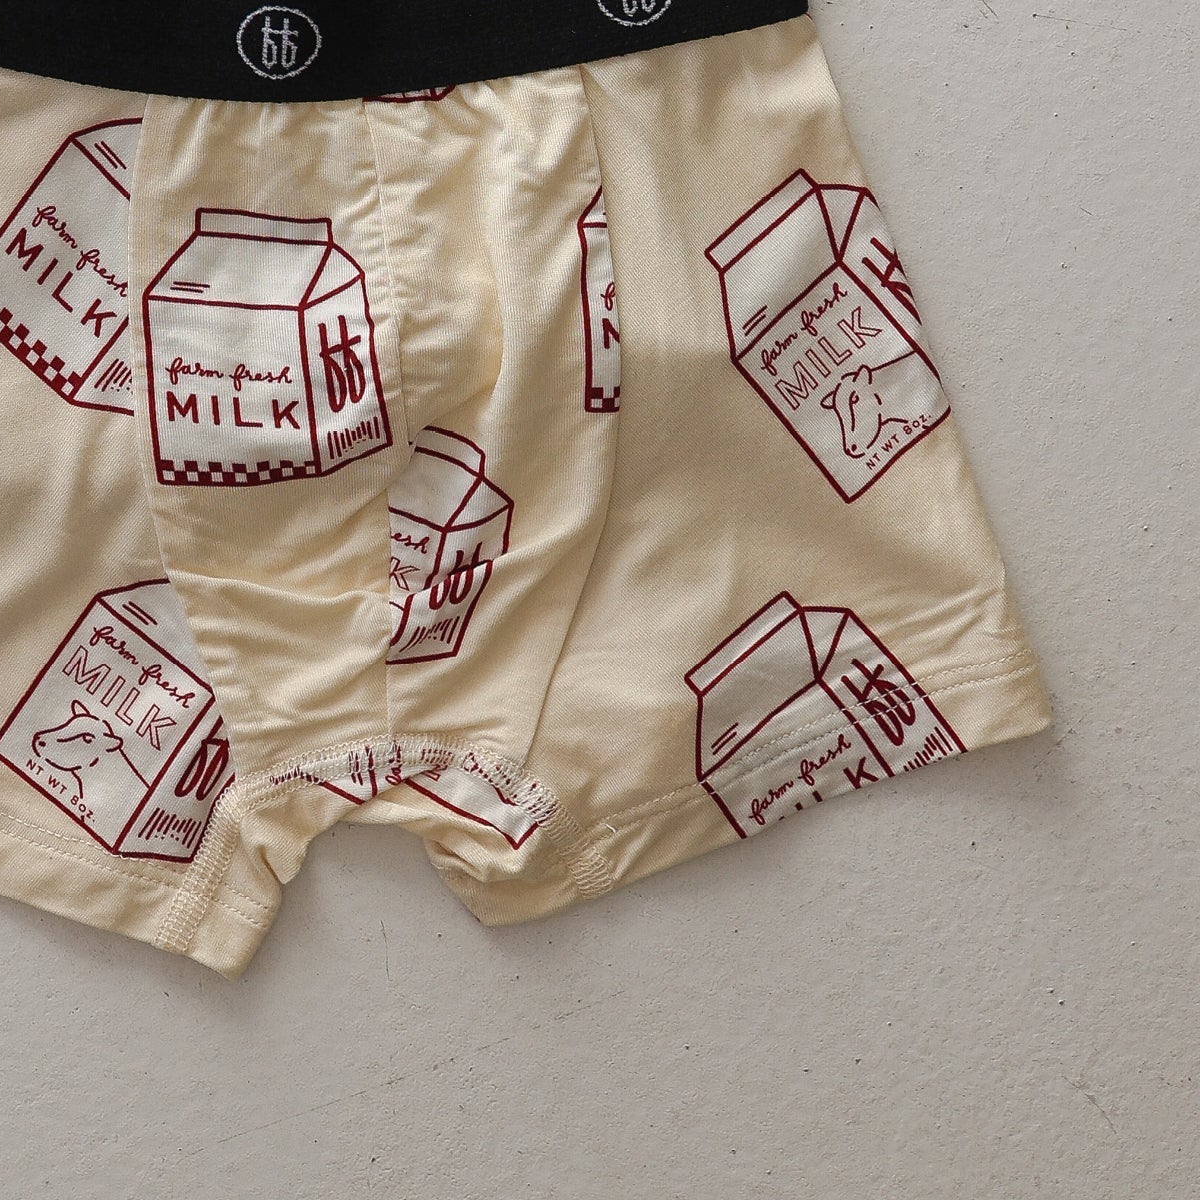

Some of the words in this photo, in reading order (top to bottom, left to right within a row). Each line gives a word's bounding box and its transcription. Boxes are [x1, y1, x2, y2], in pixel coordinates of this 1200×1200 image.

[5, 228, 117, 338] MILK
[32, 206, 77, 249] farm
[76, 249, 128, 297] fresh
[761, 332, 798, 376] farm
[801, 283, 848, 336] fresh
[775, 306, 882, 410] MILK
[165, 357, 224, 385] farm
[229, 364, 292, 391] fresh
[166, 391, 300, 429] MILK
[865, 453, 882, 470] NT
[881, 435, 901, 453] WT
[390, 532, 430, 554] esh
[62, 645, 176, 751] MILK
[89, 626, 138, 665] farm
[138, 664, 195, 708] fresh
[26, 759, 44, 775] NT
[48, 775, 67, 795] WT
[749, 780, 794, 825] farm
[798, 734, 851, 786] fresh
